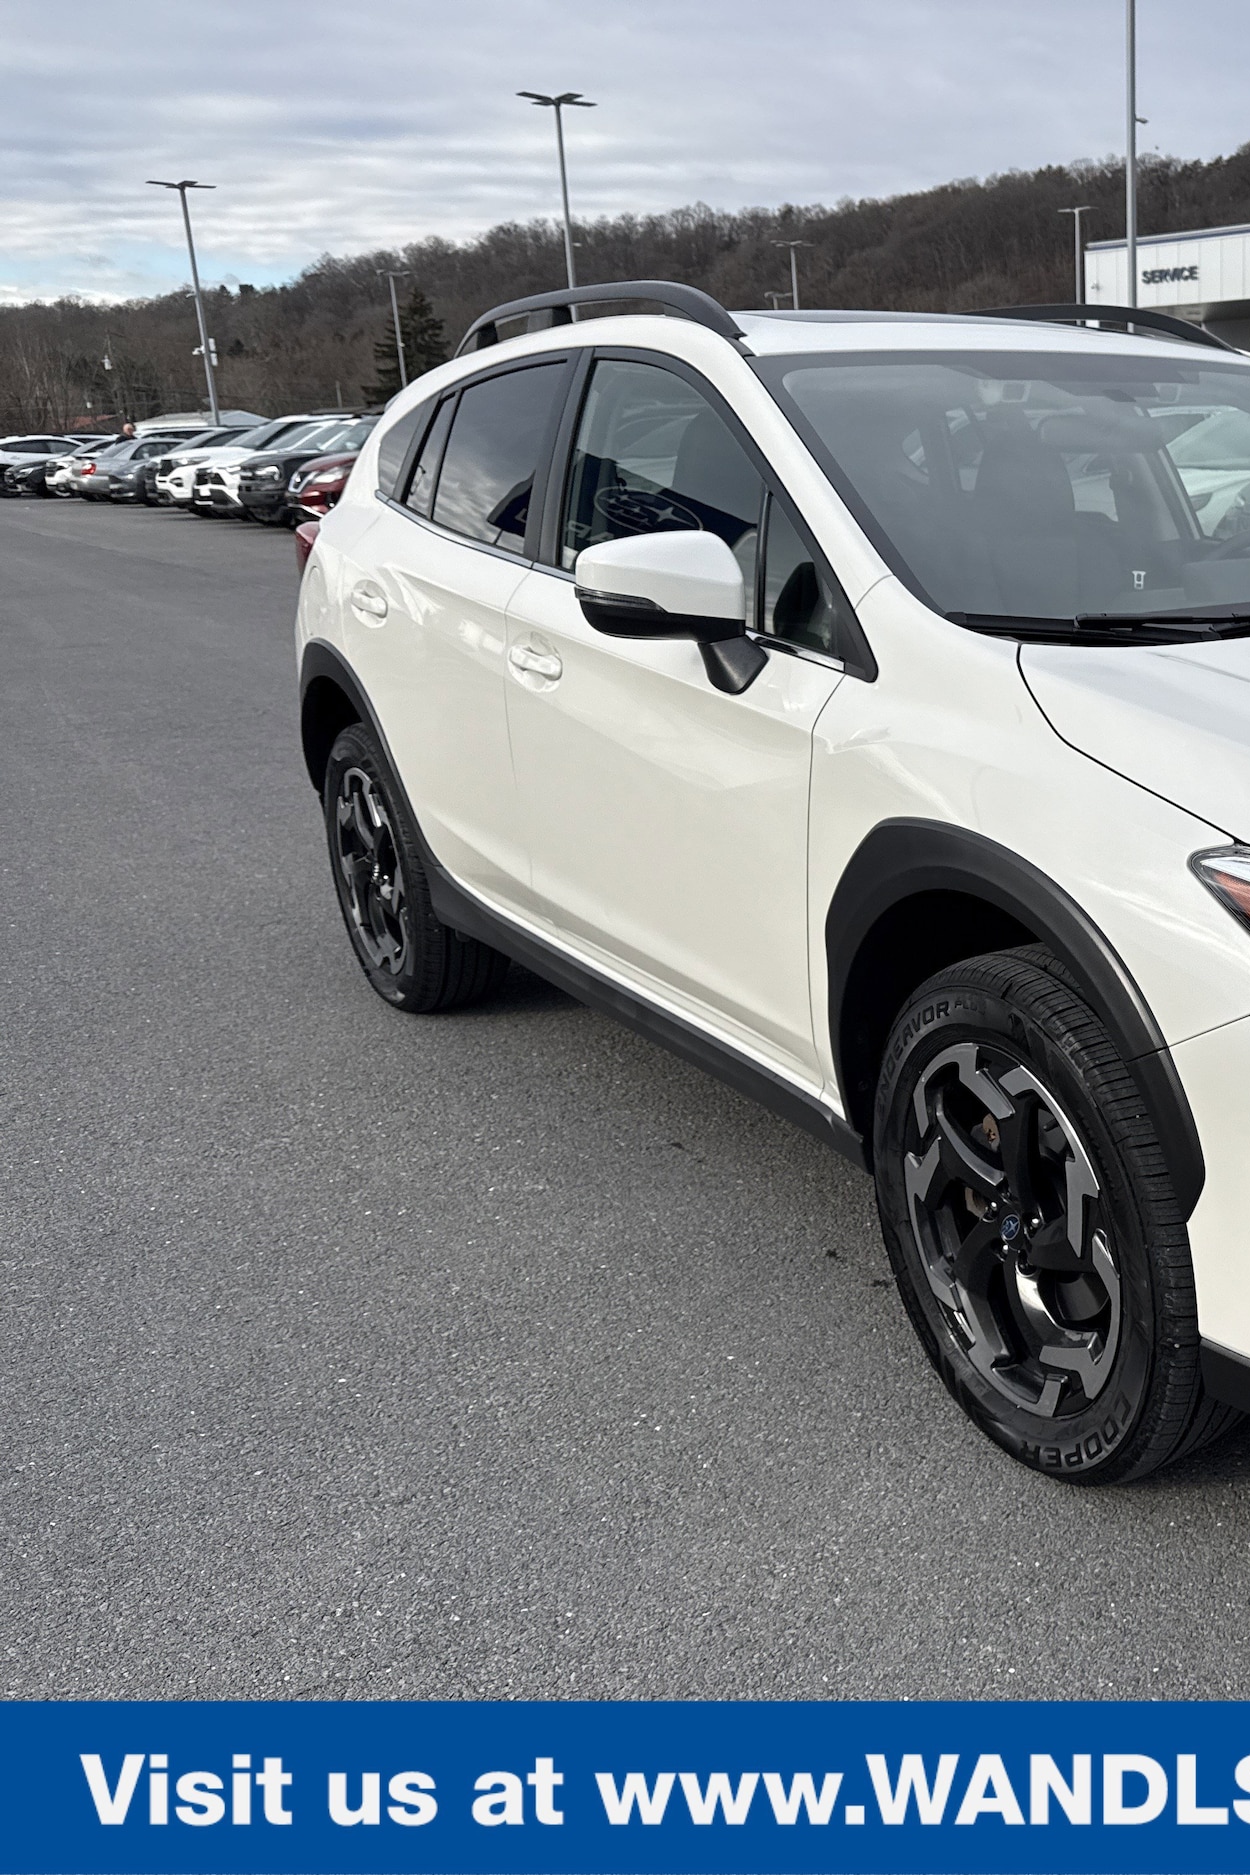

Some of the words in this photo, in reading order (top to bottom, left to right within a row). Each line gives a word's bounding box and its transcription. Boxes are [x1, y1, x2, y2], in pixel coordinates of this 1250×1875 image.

[1142, 266, 1199, 285] SERVICE
[876, 1000, 950, 1114] ENDEAVOR
[1019, 1391, 1132, 1470] COOPER
